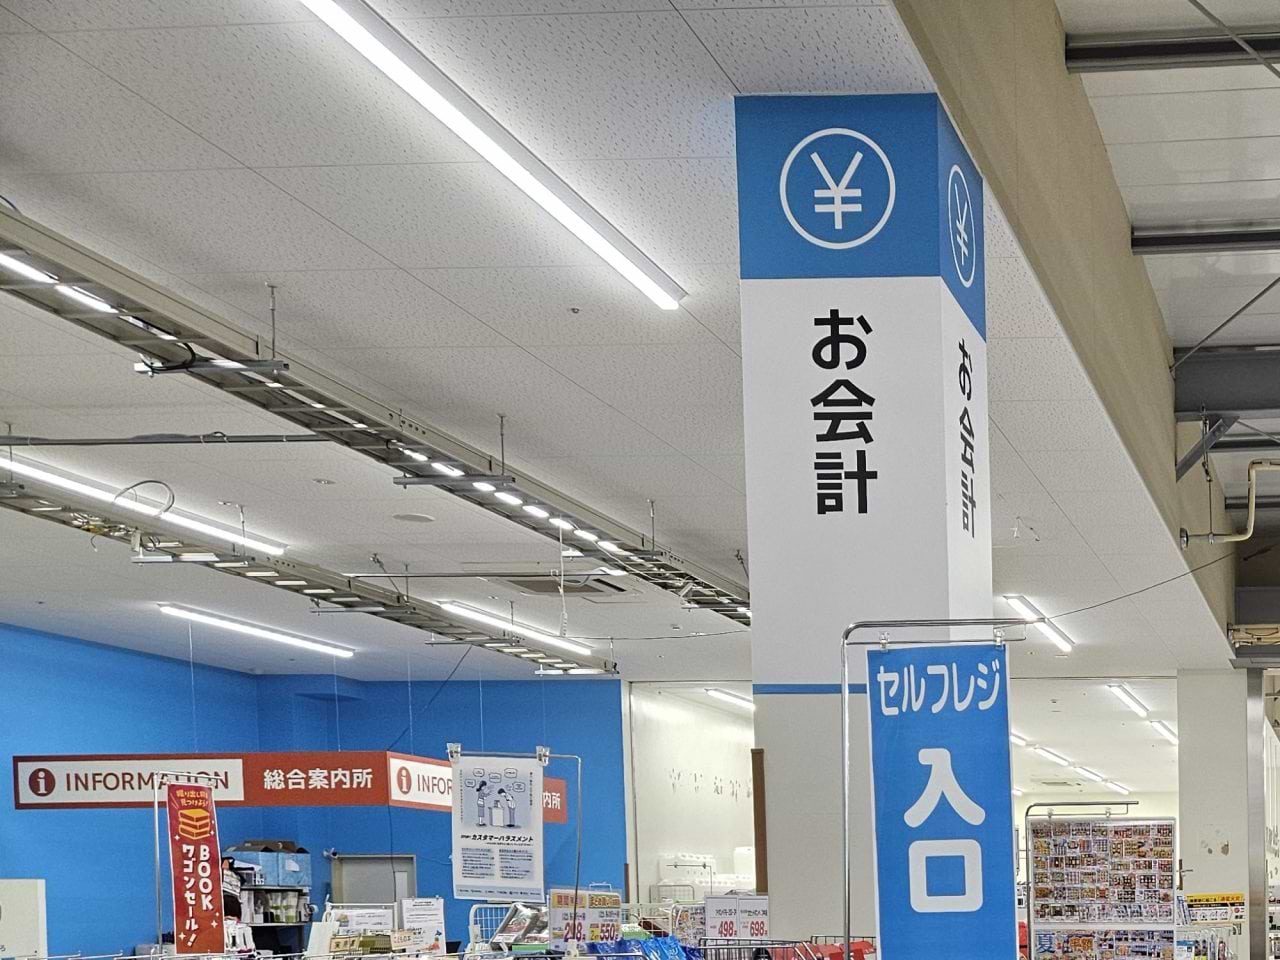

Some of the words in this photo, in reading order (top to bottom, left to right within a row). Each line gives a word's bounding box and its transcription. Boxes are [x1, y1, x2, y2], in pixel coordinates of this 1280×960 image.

[810, 308, 877, 515] お会計
[957, 337, 977, 538] お会計
[877, 658, 1000, 716] セルフレジ
[263, 768, 373, 790] 総合案内所
[903, 747, 986, 914] 入口
[182, 844, 199, 947] ワゴンセール!
[198, 844, 213, 910] BOOK
